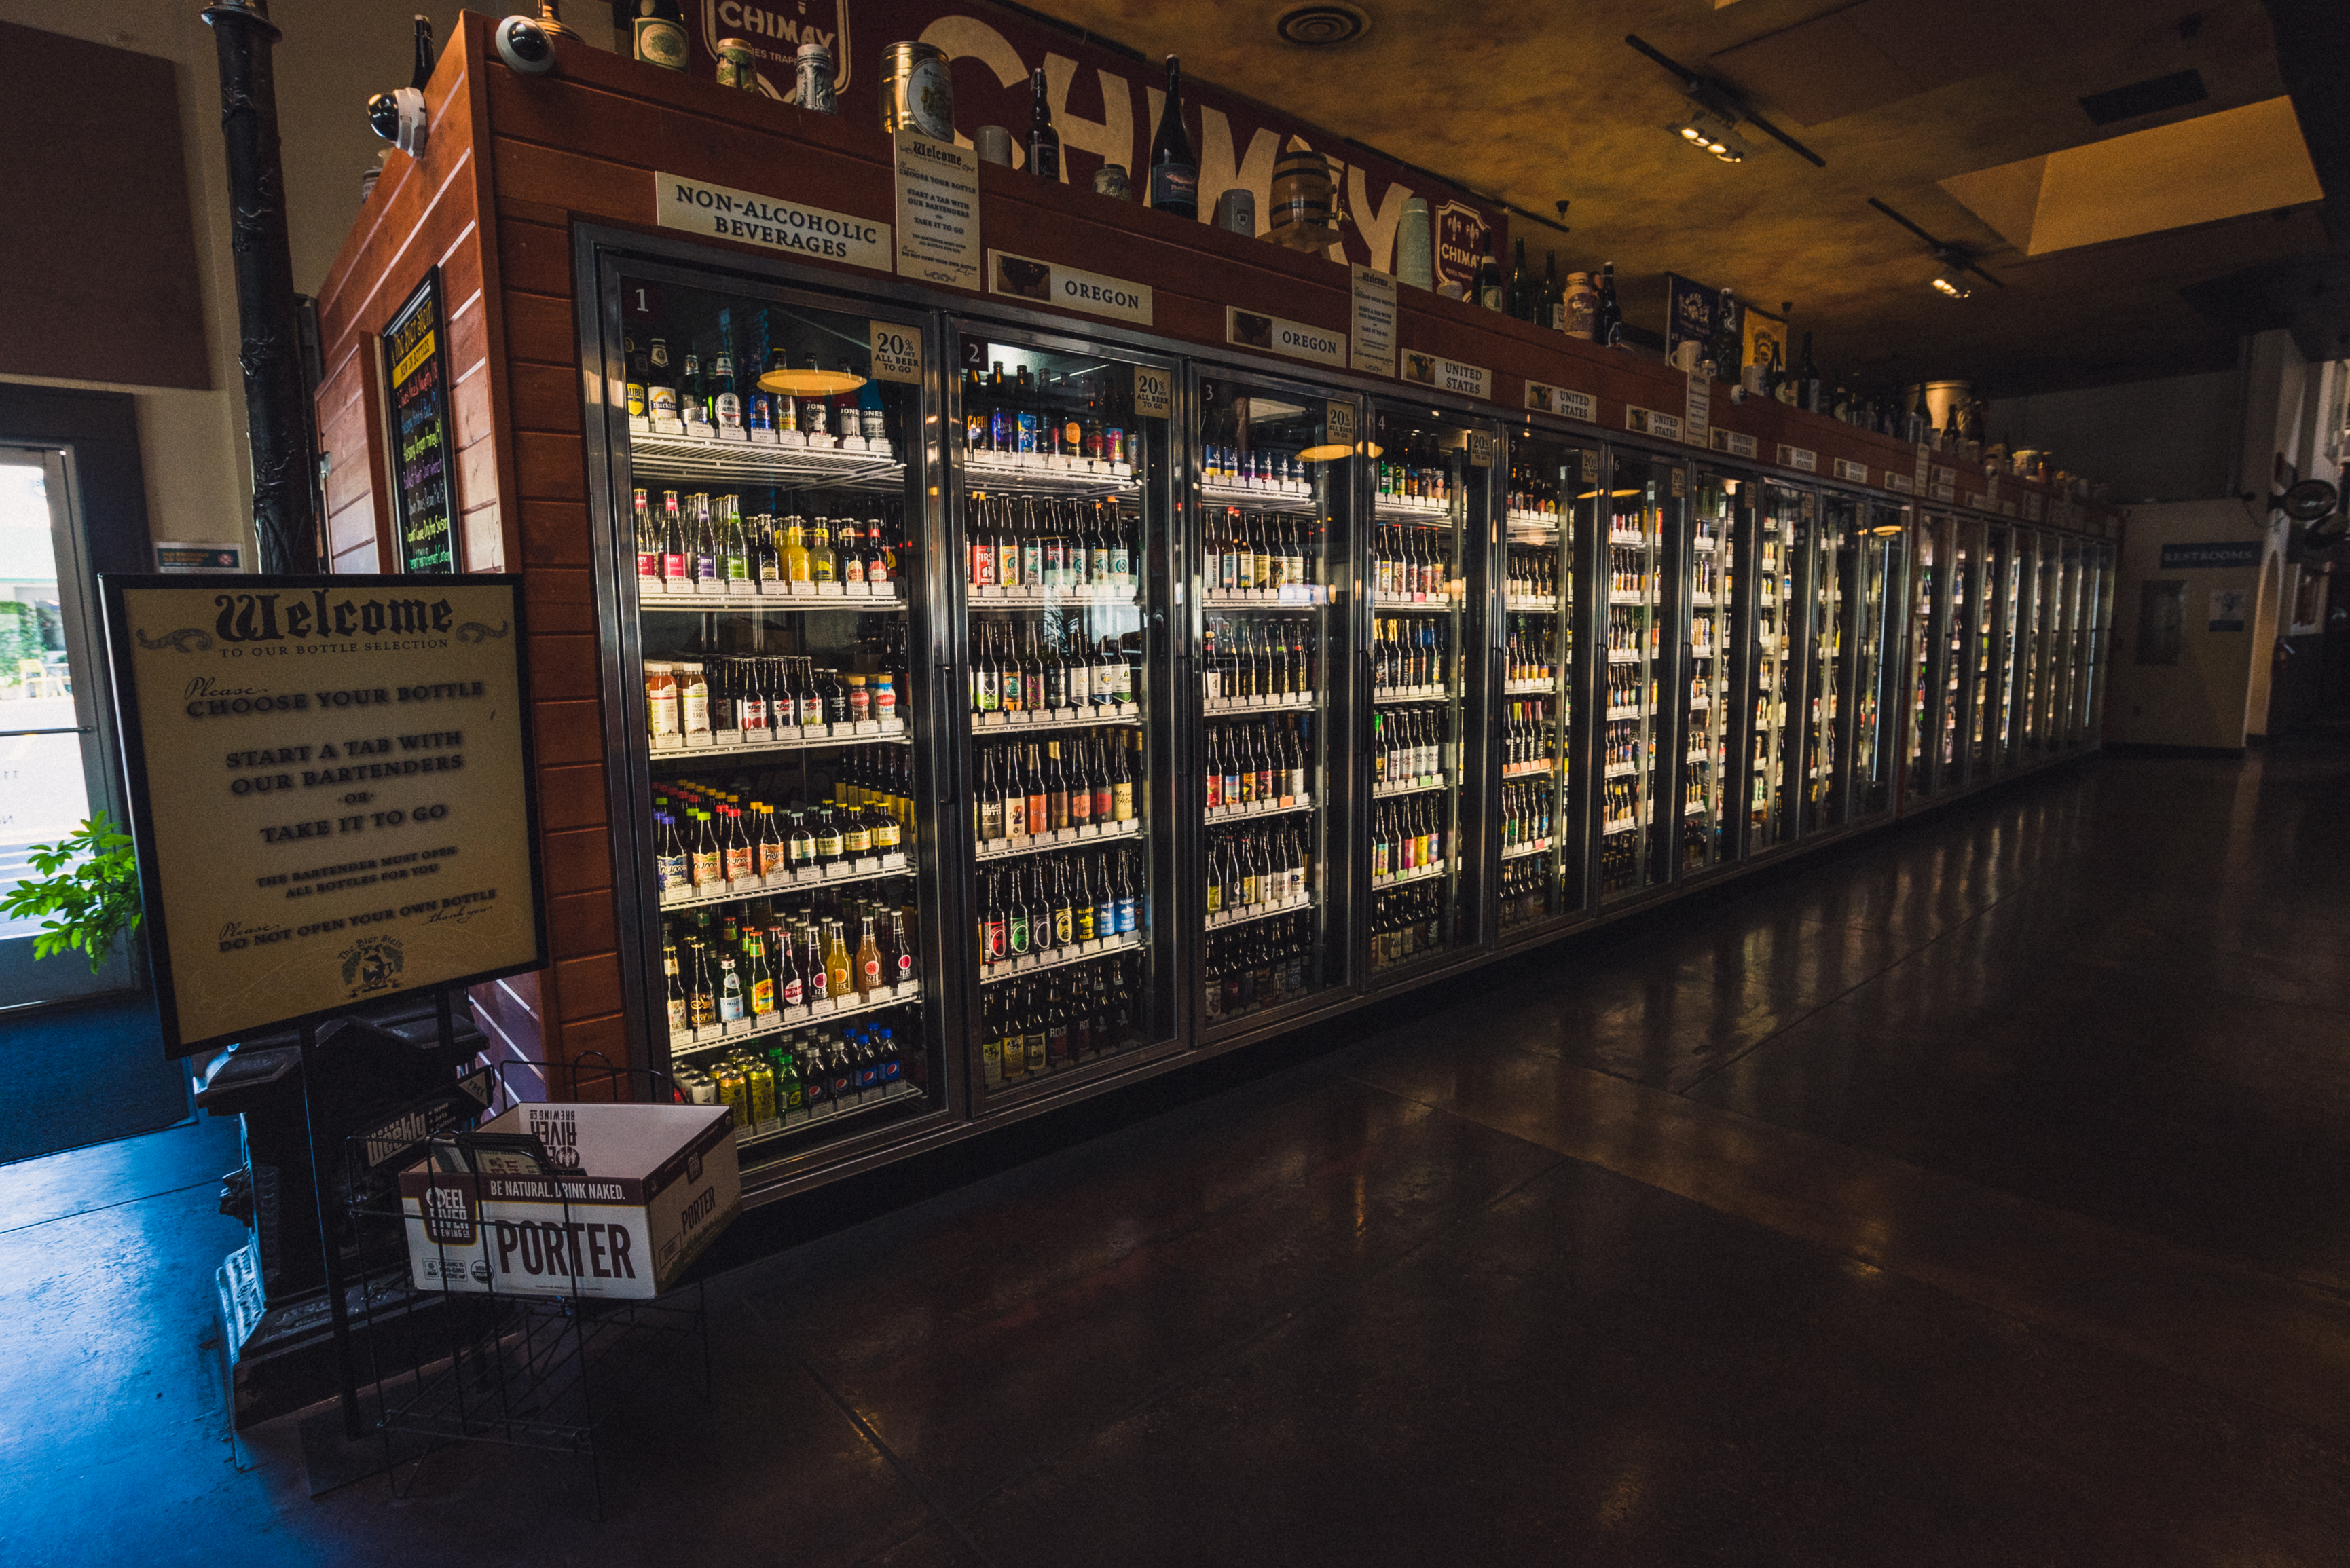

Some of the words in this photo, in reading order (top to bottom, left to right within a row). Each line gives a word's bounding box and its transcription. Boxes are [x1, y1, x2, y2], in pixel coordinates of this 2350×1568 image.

[718, 1, 836, 49] CHIMAY
[913, 141, 962, 166] Welcome
[899, 168, 928, 182] CHOOSE
[930, 174, 949, 187] YOUR
[951, 183, 976, 194] BOTTLE
[907, 188, 930, 199] START
[951, 199, 970, 210] WITH
[908, 198, 923, 207] OUR
[925, 202, 970, 219] BARTENDERS
[676, 185, 877, 244] NON-ALCOHOLIC
[914, 217, 933, 228] TAKE
[934, 221, 942, 229] IT
[943, 223, 952, 232] TO
[953, 226, 964, 235] GO
[715, 216, 847, 259] BEVERAGES
[1441, 242, 1480, 269] CHIMA
[634, 288, 650, 312] 1
[1065, 280, 1139, 310] OREGON
[968, 344, 980, 362] 2
[1282, 331, 1336, 354] OREGON
[875, 354, 898, 364] ALL
[899, 356, 919, 367] BEER
[883, 362, 898, 371] TO
[898, 364, 911, 374] GO
[1445, 362, 1482, 381] UNITED
[1206, 384, 1213, 400] 3
[1446, 377, 1480, 395] STATES
[807, 403, 826, 411] JONE
[1152, 396, 1169, 404] BEER
[1560, 391, 1590, 407] UNITED
[1561, 404, 1588, 419] STATES
[1654, 413, 1678, 428] UNITED
[1378, 415, 1386, 430] 4
[1655, 425, 1676, 439] STATES
[978, 553, 993, 562] FIRS
[215, 589, 454, 644] Welcome
[219, 648, 243, 658] TO
[251, 647, 289, 657] OUR
[297, 643, 359, 656] BOTTLE
[365, 639, 448, 652] SELECTION
[184, 677, 268, 701] Please
[186, 694, 308, 717] CHOOSE
[316, 688, 388, 708] YOUR
[397, 682, 484, 702] BOTTLE
[226, 747, 311, 768] START
[319, 744, 337, 760] A
[344, 738, 390, 758] TAB
[397, 732, 462, 751] WITH
[231, 774, 293, 795] OUR
[304, 755, 464, 787] BARTENDERS
[260, 821, 329, 844] TAKE
[339, 815, 363, 832] IT
[370, 810, 403, 827] TO
[412, 804, 446, 821] GO
[255, 876, 287, 888] THE
[291, 861, 376, 883] BARTENDER
[381, 855, 418, 870] MUST
[422, 846, 457, 862] OPEN
[285, 887, 311, 899] ALL
[316, 876, 377, 893] BOTTLES
[381, 870, 407, 883] FOR
[411, 864, 439, 877] YOU
[219, 939, 249, 953] DO
[253, 931, 292, 948] NOT
[297, 920, 344, 938] OPEN
[349, 911, 396, 929] YOUR
[399, 901, 438, 919] OWN
[441, 890, 496, 910] BOTTLE
[422, 908, 460, 925] thank
[459, 905, 493, 924] you
[219, 922, 279, 941] Please
[337, 946, 355, 959] The
[356, 937, 378, 947] Bier
[381, 935, 403, 948] Stein
[1050, 1025, 1067, 1038] ROGU
[468, 1079, 485, 1098] FREE
[530, 1110, 538, 1120] CO
[539, 1110, 575, 1121] BREWING
[367, 1112, 427, 1168] Weekly
[530, 1121, 577, 1146] RIVER
[445, 1188, 466, 1209] EEL
[490, 1180, 503, 1196] BE
[505, 1180, 554, 1198] NATURAL.
[589, 1183, 626, 1200] NAKED.
[681, 1185, 716, 1236] PORTER
[433, 1229, 463, 1238] BEWING
[463, 1229, 471, 1238] CO
[495, 1219, 636, 1280] PORTER
